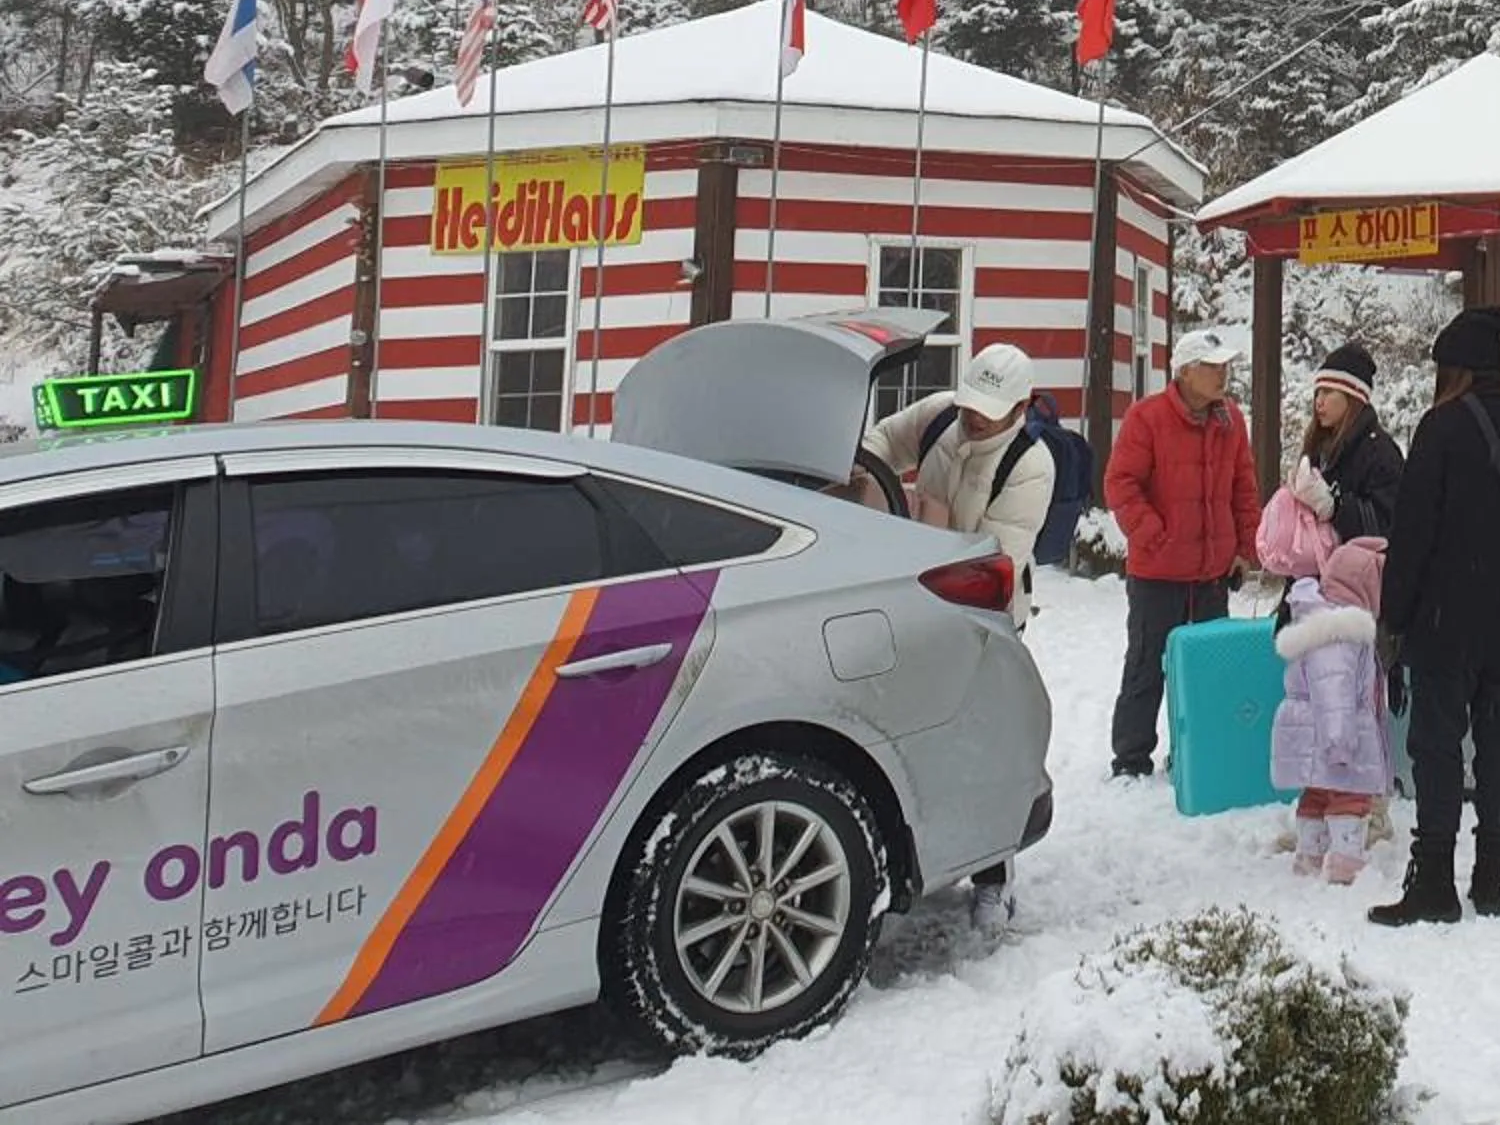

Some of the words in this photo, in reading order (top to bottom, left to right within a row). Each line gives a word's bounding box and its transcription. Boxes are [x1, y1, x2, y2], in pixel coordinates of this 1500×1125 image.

[436, 179, 640, 251] HeidiHaus
[77, 382, 170, 413] TAXI
[143, 790, 378, 902] onda
[15, 925, 193, 994] 스마일콜과
[203, 884, 369, 952] 함께합니다
